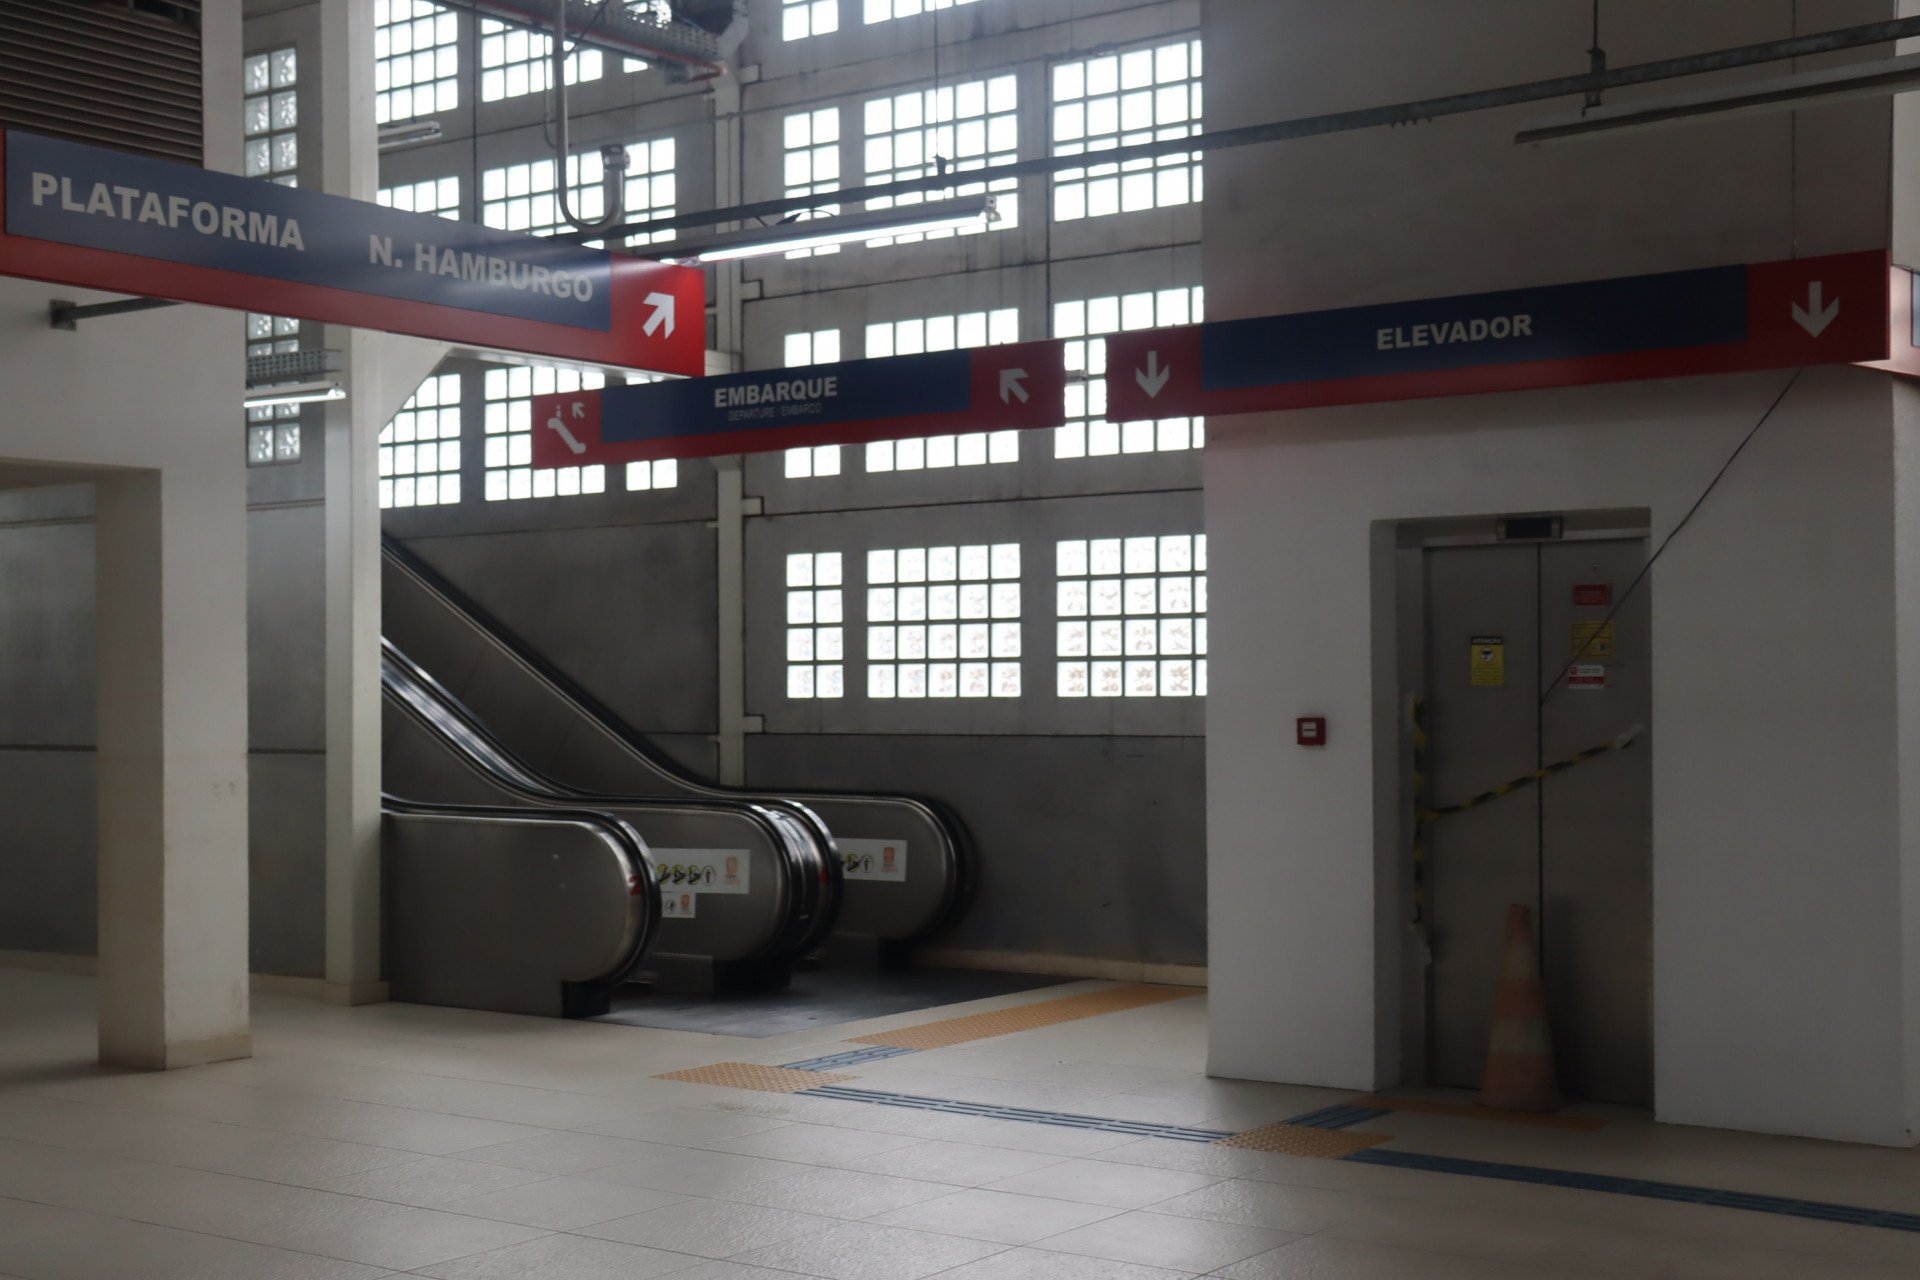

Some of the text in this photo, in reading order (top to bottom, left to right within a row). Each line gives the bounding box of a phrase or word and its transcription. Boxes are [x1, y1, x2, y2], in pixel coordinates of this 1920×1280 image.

[32, 171, 594, 302] PLATAFORMA N. HAMBURGO
[1376, 314, 1533, 350] ELEVADOR
[714, 376, 838, 408] EMBARQUE
